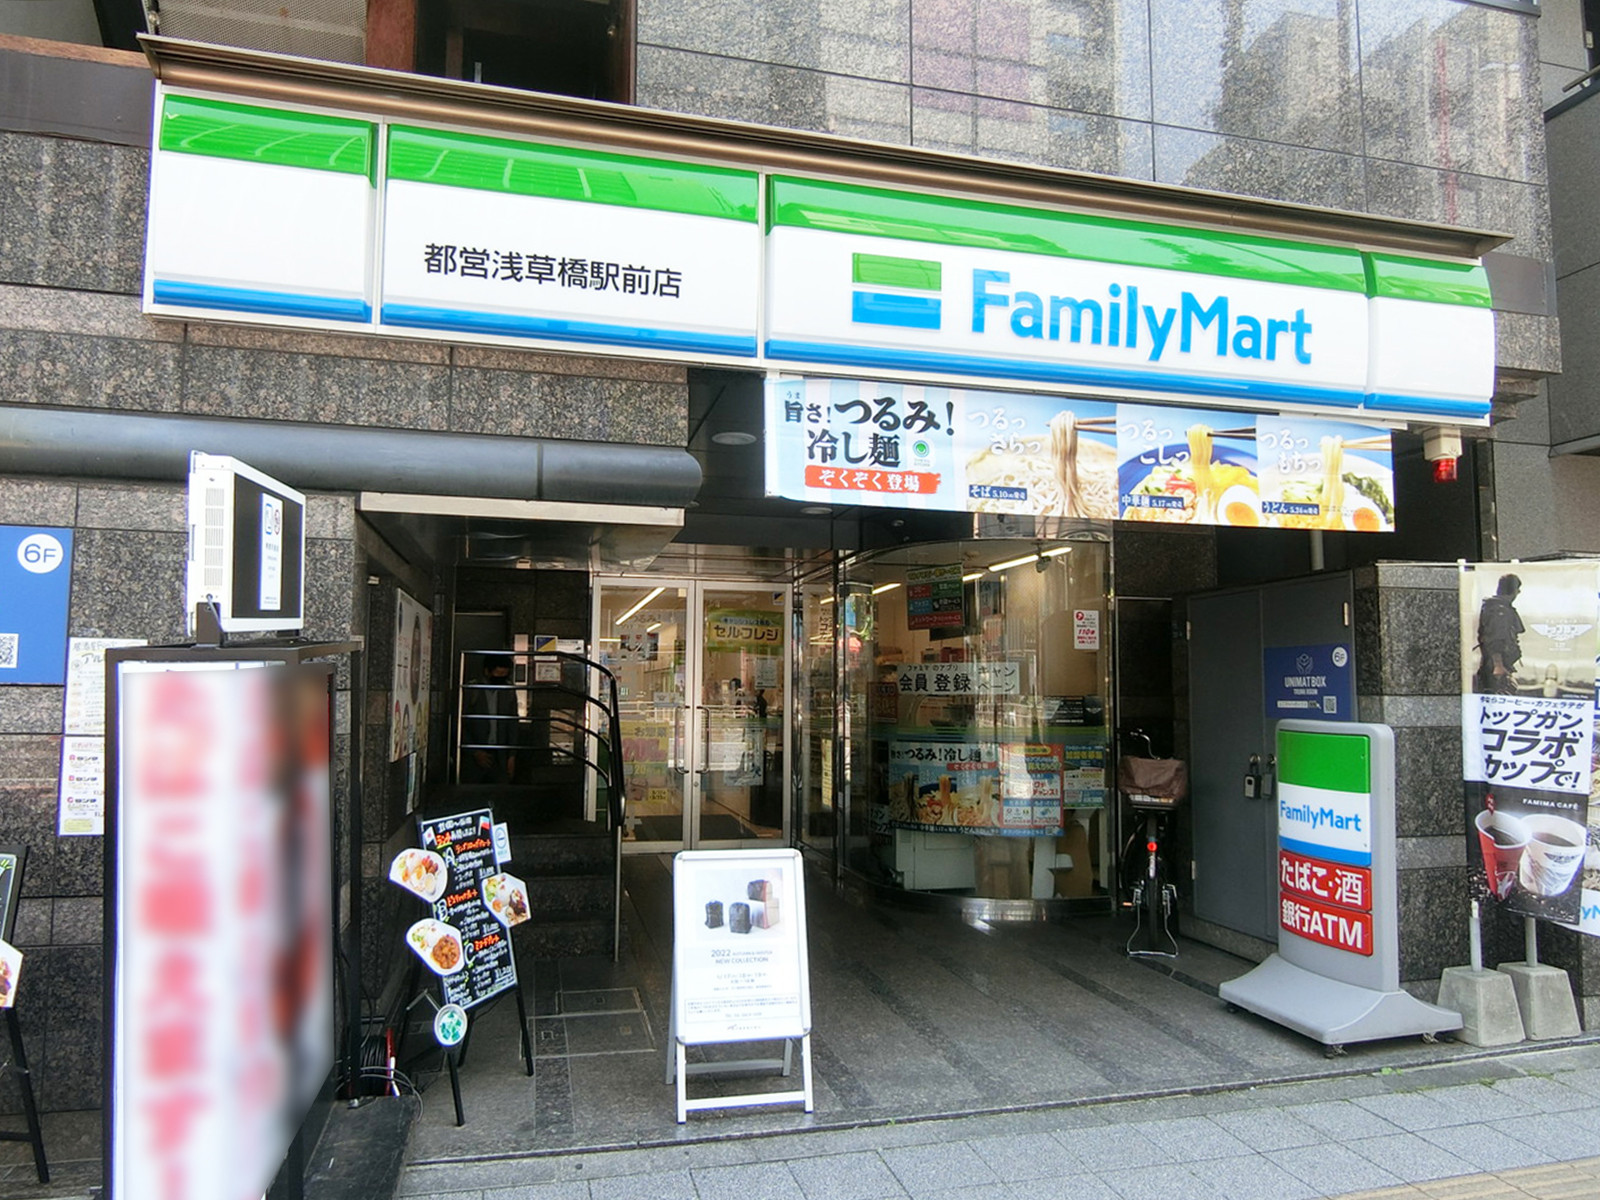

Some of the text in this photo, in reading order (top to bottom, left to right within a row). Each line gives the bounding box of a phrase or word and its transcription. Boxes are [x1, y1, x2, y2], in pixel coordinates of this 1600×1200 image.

[424, 243, 682, 299] 都営浅草橋駅前店
[971, 268, 1313, 365] FamilyMart
[834, 396, 955, 436] つるみ!
[967, 407, 1026, 431] つるっ
[1119, 419, 1174, 441] つるっ
[1259, 429, 1310, 450] つるっ
[807, 428, 901, 468] 冷し麺
[1139, 446, 1191, 466] こしっ
[818, 468, 921, 492] ぞくぞく登場
[970, 485, 991, 498] そば
[1263, 502, 1288, 514] うどん
[23, 543, 57, 564] 6F
[713, 624, 779, 641] セルフレジ
[899, 673, 972, 692] 会員登録
[1480, 706, 1584, 731] トップガン
[1482, 728, 1584, 759] コラボ
[1485, 754, 1581, 789] カップで!
[1522, 798, 1555, 808] FAMIMA
[1280, 800, 1362, 832] FamilyMart
[1282, 899, 1363, 949] 銀行ATM
[711, 949, 732, 958] 2022
[731, 956, 769, 964] COLLECTION
